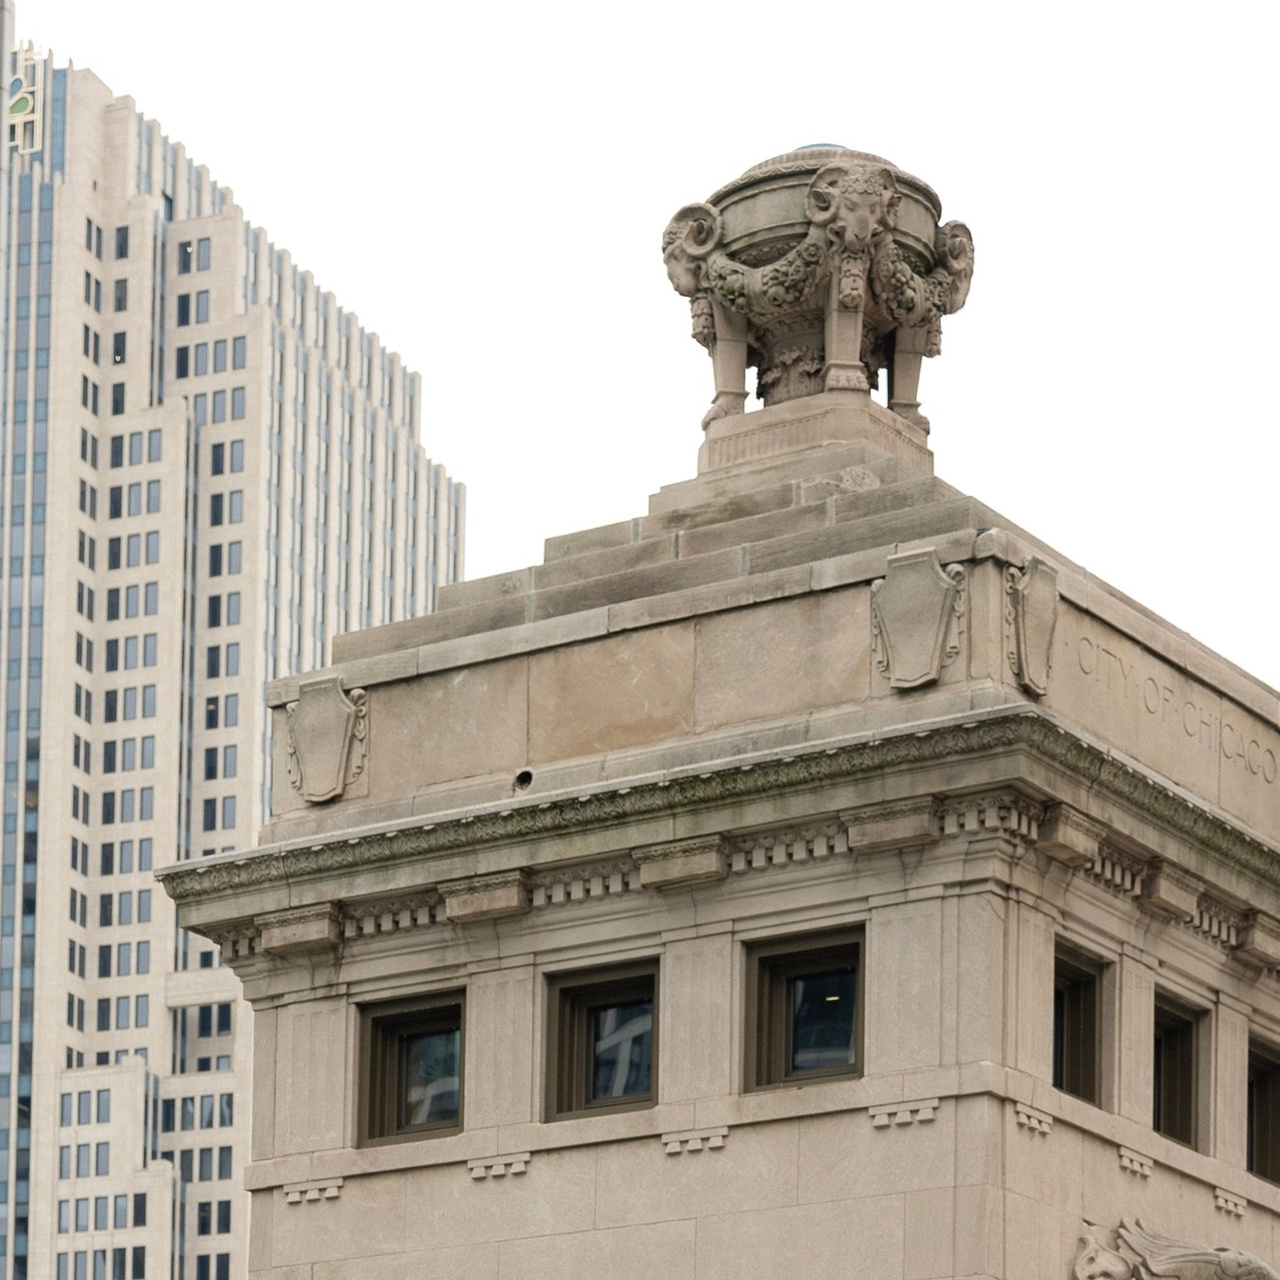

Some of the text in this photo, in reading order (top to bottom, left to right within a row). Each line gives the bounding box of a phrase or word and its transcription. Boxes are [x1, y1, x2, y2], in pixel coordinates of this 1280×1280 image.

[1078, 637, 1277, 784] CITY OF CHICAGO
